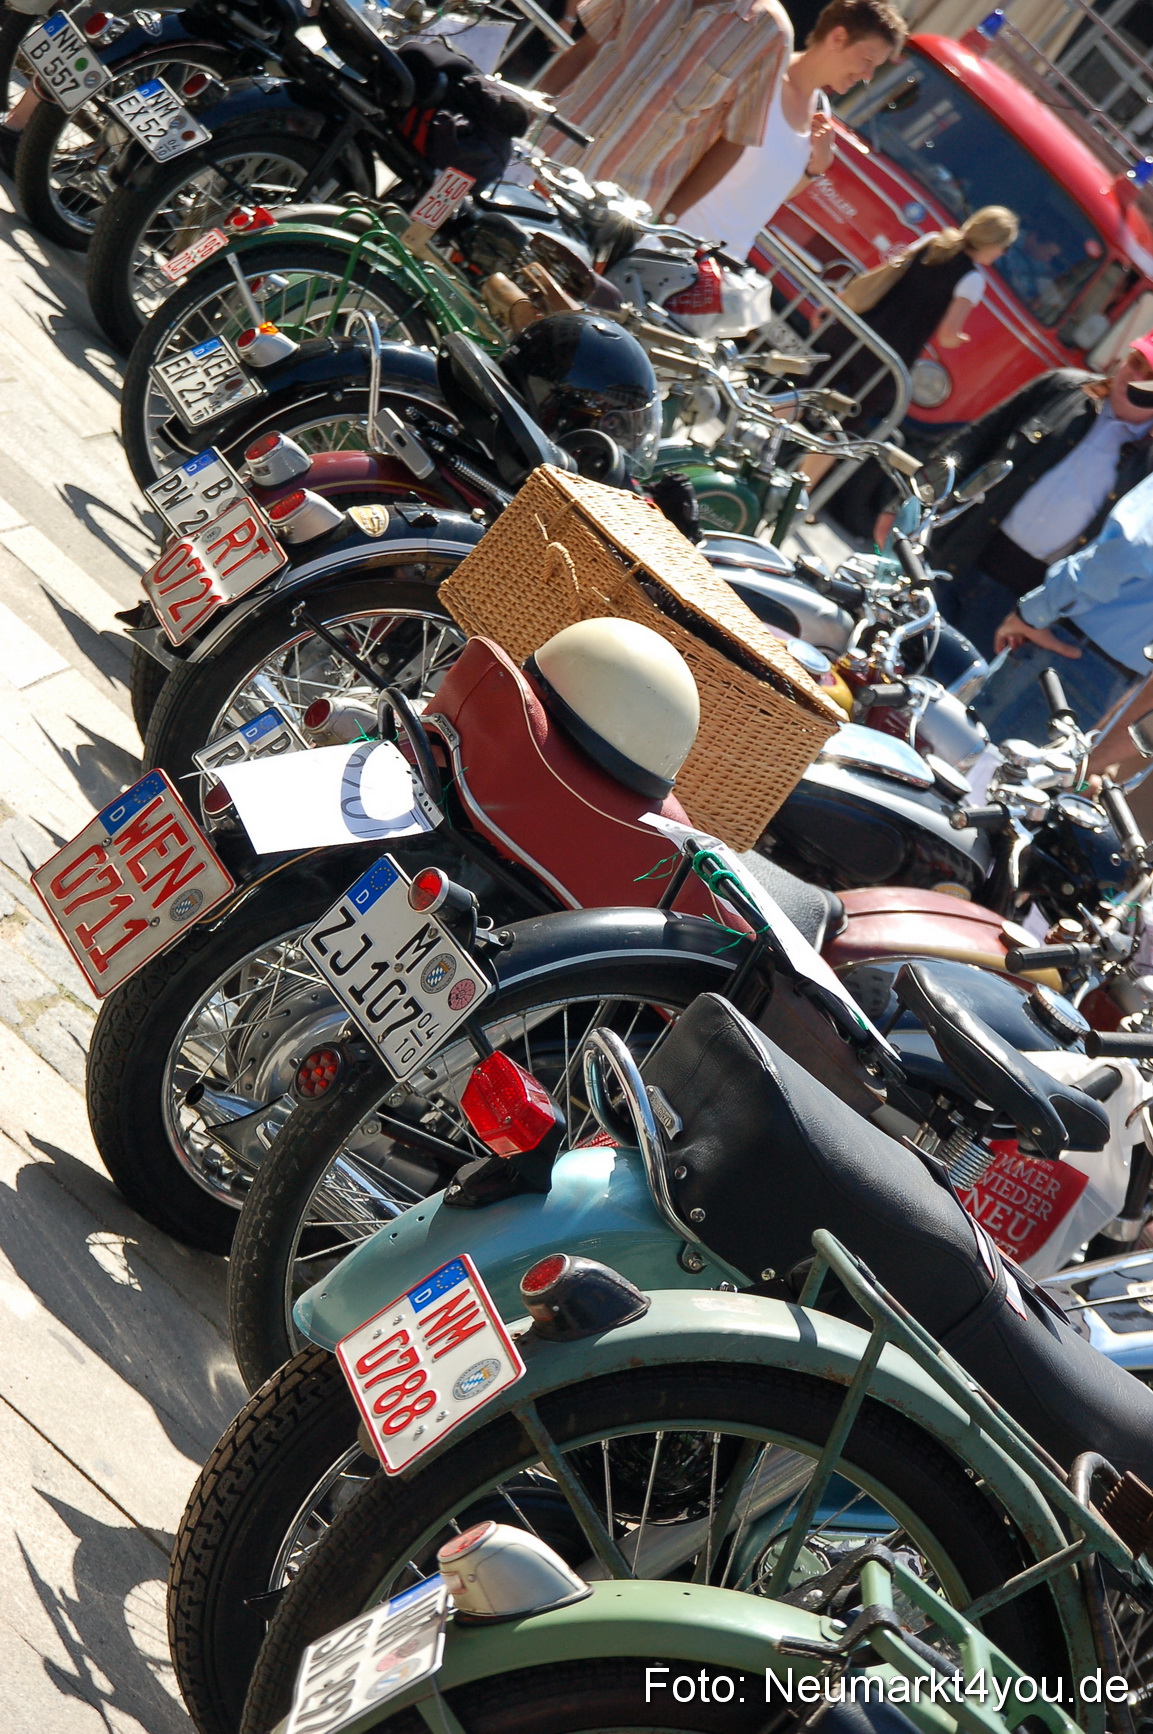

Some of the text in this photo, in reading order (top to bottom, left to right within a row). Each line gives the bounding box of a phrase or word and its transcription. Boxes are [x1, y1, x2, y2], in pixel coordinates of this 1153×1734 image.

[30, 40, 81, 96] B 557
[52, 28, 80, 60] NM
[116, 95, 168, 143] EX 52
[149, 90, 179, 117] NM
[417, 196, 450, 221] ZCU
[437, 173, 469, 200] 140
[197, 233, 220, 256] 196
[162, 356, 213, 408] EN 21
[198, 348, 241, 387] KEH
[151, 474, 194, 511] PW
[202, 476, 234, 500] B
[206, 517, 272, 579] RT
[153, 543, 224, 634] 0721
[113, 795, 208, 910] WEN
[48, 843, 152, 975] 0711
[395, 922, 441, 974] M
[310, 906, 424, 1043] ZJ 107
[394, 1038, 417, 1064] 10
[418, 1012, 440, 1040] 04
[963, 1188, 1036, 1242] NEU
[417, 1288, 490, 1362] NM
[354, 1328, 438, 1438] 0788
